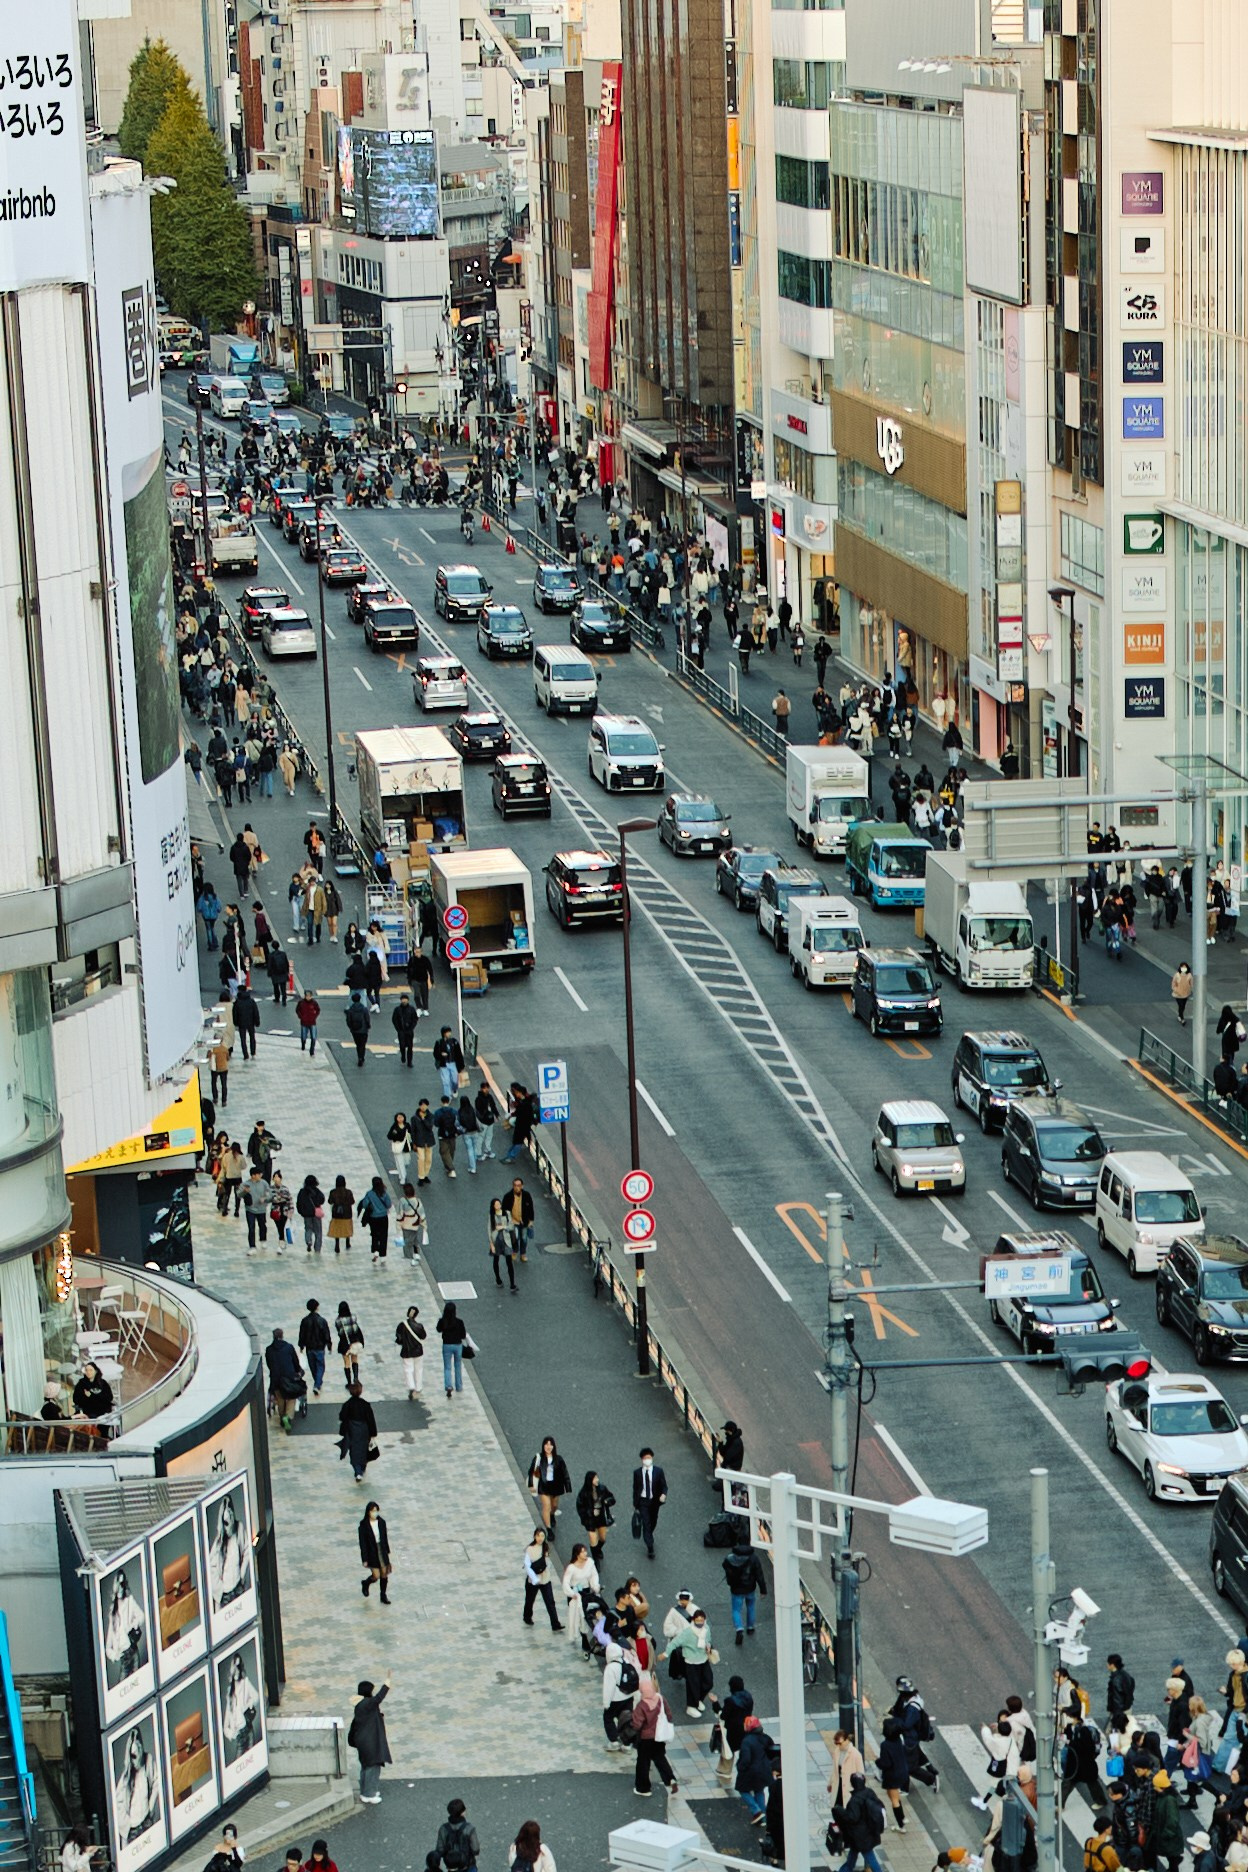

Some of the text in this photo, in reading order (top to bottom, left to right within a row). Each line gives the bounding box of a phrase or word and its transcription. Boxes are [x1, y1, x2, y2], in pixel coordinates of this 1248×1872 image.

[1132, 180, 1152, 192] YM
[1127, 294, 1157, 311] くら
[1127, 312, 1157, 320] KURA
[1132, 349, 1152, 361] YM
[1132, 404, 1153, 417] YM
[876, 416, 905, 475] UGG
[1134, 461, 1152, 471] YM
[1134, 576, 1153, 587] YM
[1127, 634, 1162, 647] KINJI
[1134, 685, 1154, 697] YM
[543, 1066, 561, 1089] P
[554, 1106, 569, 1120] IN
[628, 1180, 646, 1195] 50
[994, 1264, 1063, 1281] 神宮前
[224, 1601, 243, 1621] CELINE
[172, 1639, 193, 1659] CELINE
[119, 1677, 141, 1698] CELINE
[236, 1754, 255, 1775] CELINE
[184, 1794, 203, 1815] CELINE
[131, 1836, 152, 1857] CELINE
